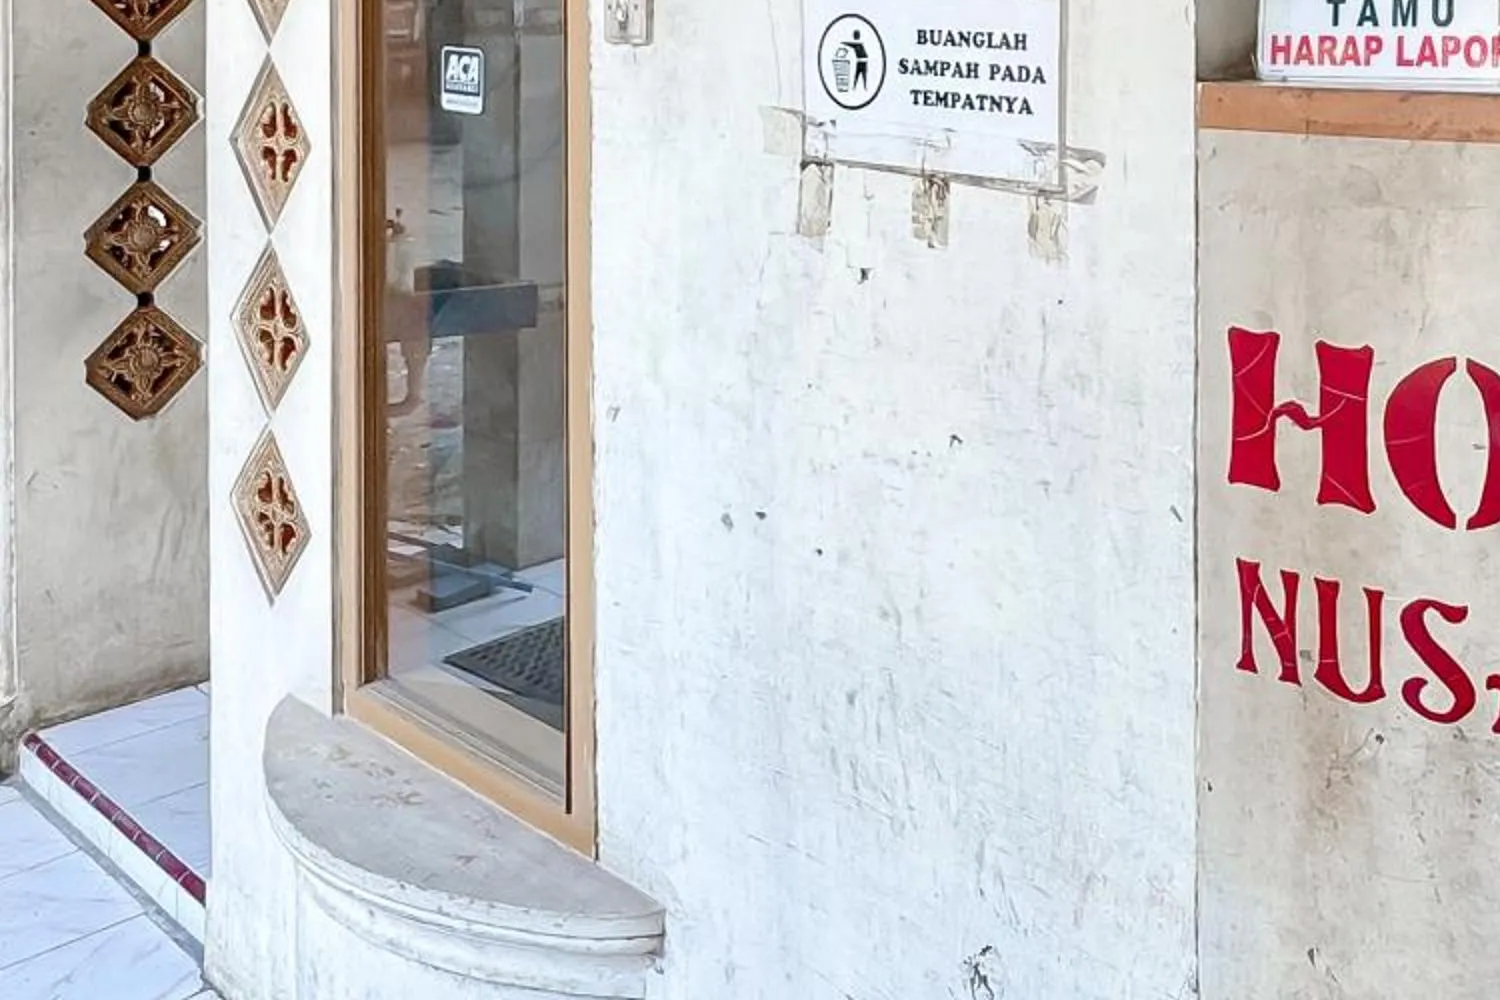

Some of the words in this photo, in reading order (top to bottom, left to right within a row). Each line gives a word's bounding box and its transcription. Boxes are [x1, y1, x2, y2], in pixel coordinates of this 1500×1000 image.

[916, 29, 1028, 51] BUANGLAH
[1270, 34, 1383, 67] HARAP
[446, 54, 479, 83] ACA
[897, 58, 980, 80] SAMPAH
[988, 63, 1047, 85] PADA
[909, 89, 1034, 116] TEMPATNYA
